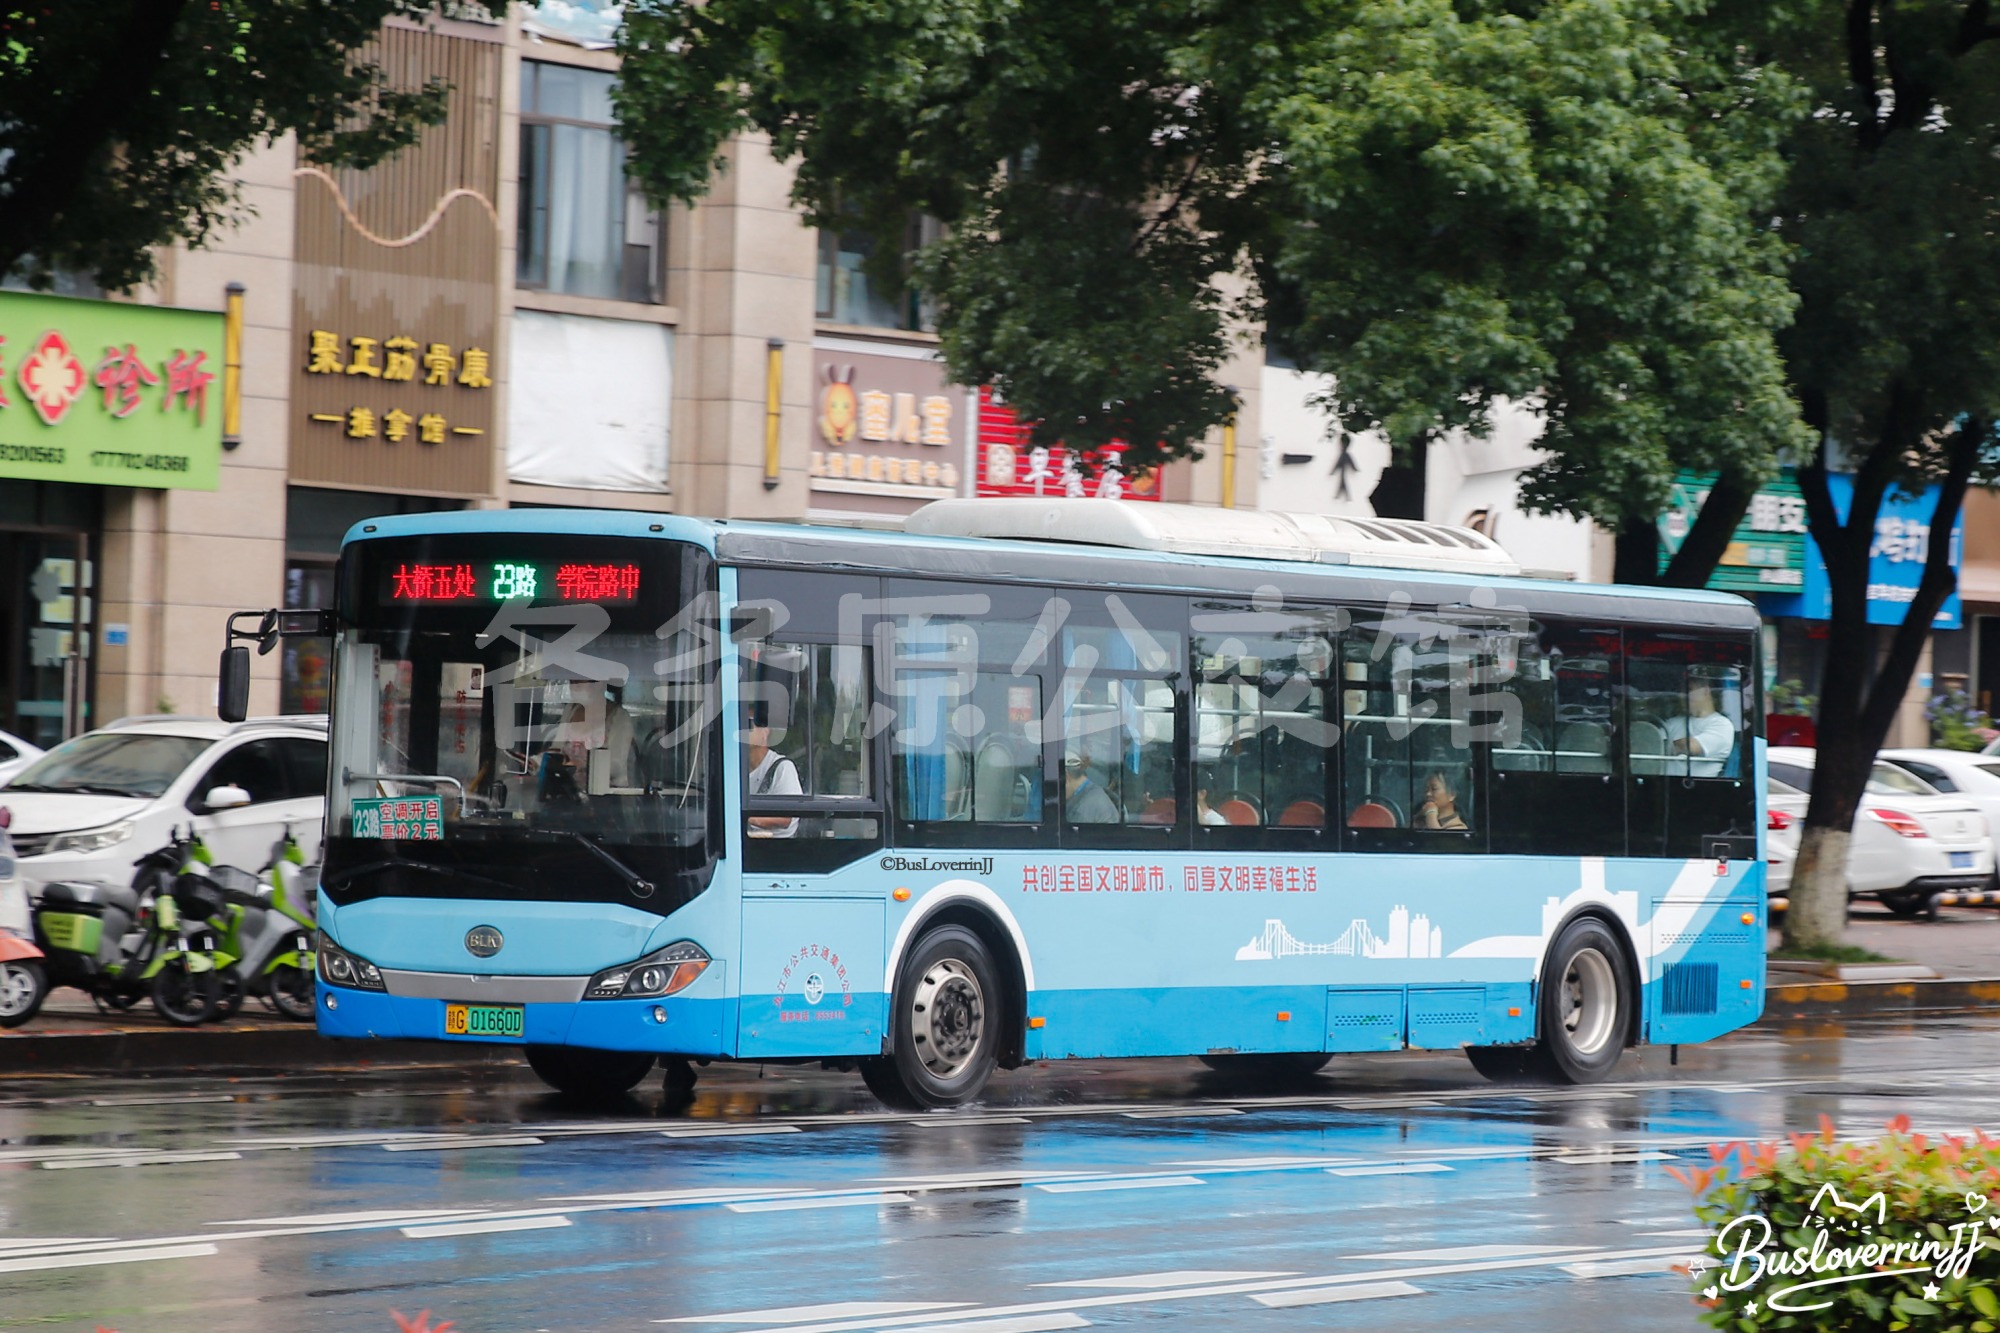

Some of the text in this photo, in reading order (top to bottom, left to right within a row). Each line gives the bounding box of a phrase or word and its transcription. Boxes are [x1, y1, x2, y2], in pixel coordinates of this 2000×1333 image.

[94, 343, 216, 427] 诊所
[393, 564, 640, 599] 大桥五处 23路 学院路中
[379, 800, 440, 821] 空调开启
[380, 822, 440, 840] 票价2元
